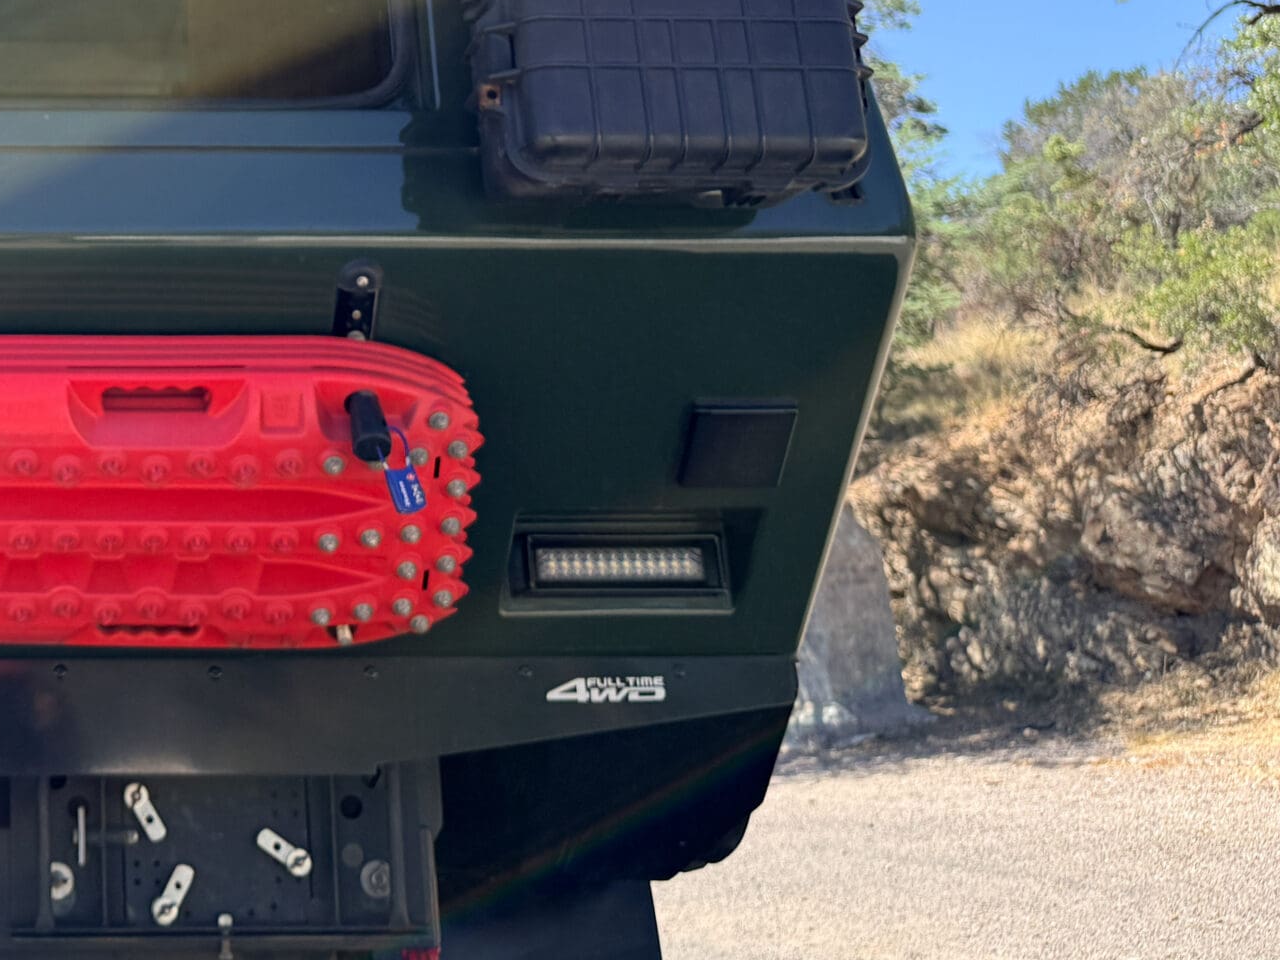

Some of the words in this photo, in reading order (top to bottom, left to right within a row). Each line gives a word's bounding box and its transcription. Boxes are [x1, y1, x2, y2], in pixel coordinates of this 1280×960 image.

[546, 676, 666, 702] 4WD
[587, 676, 626, 688] FULL
[626, 676, 664, 687] TIME
